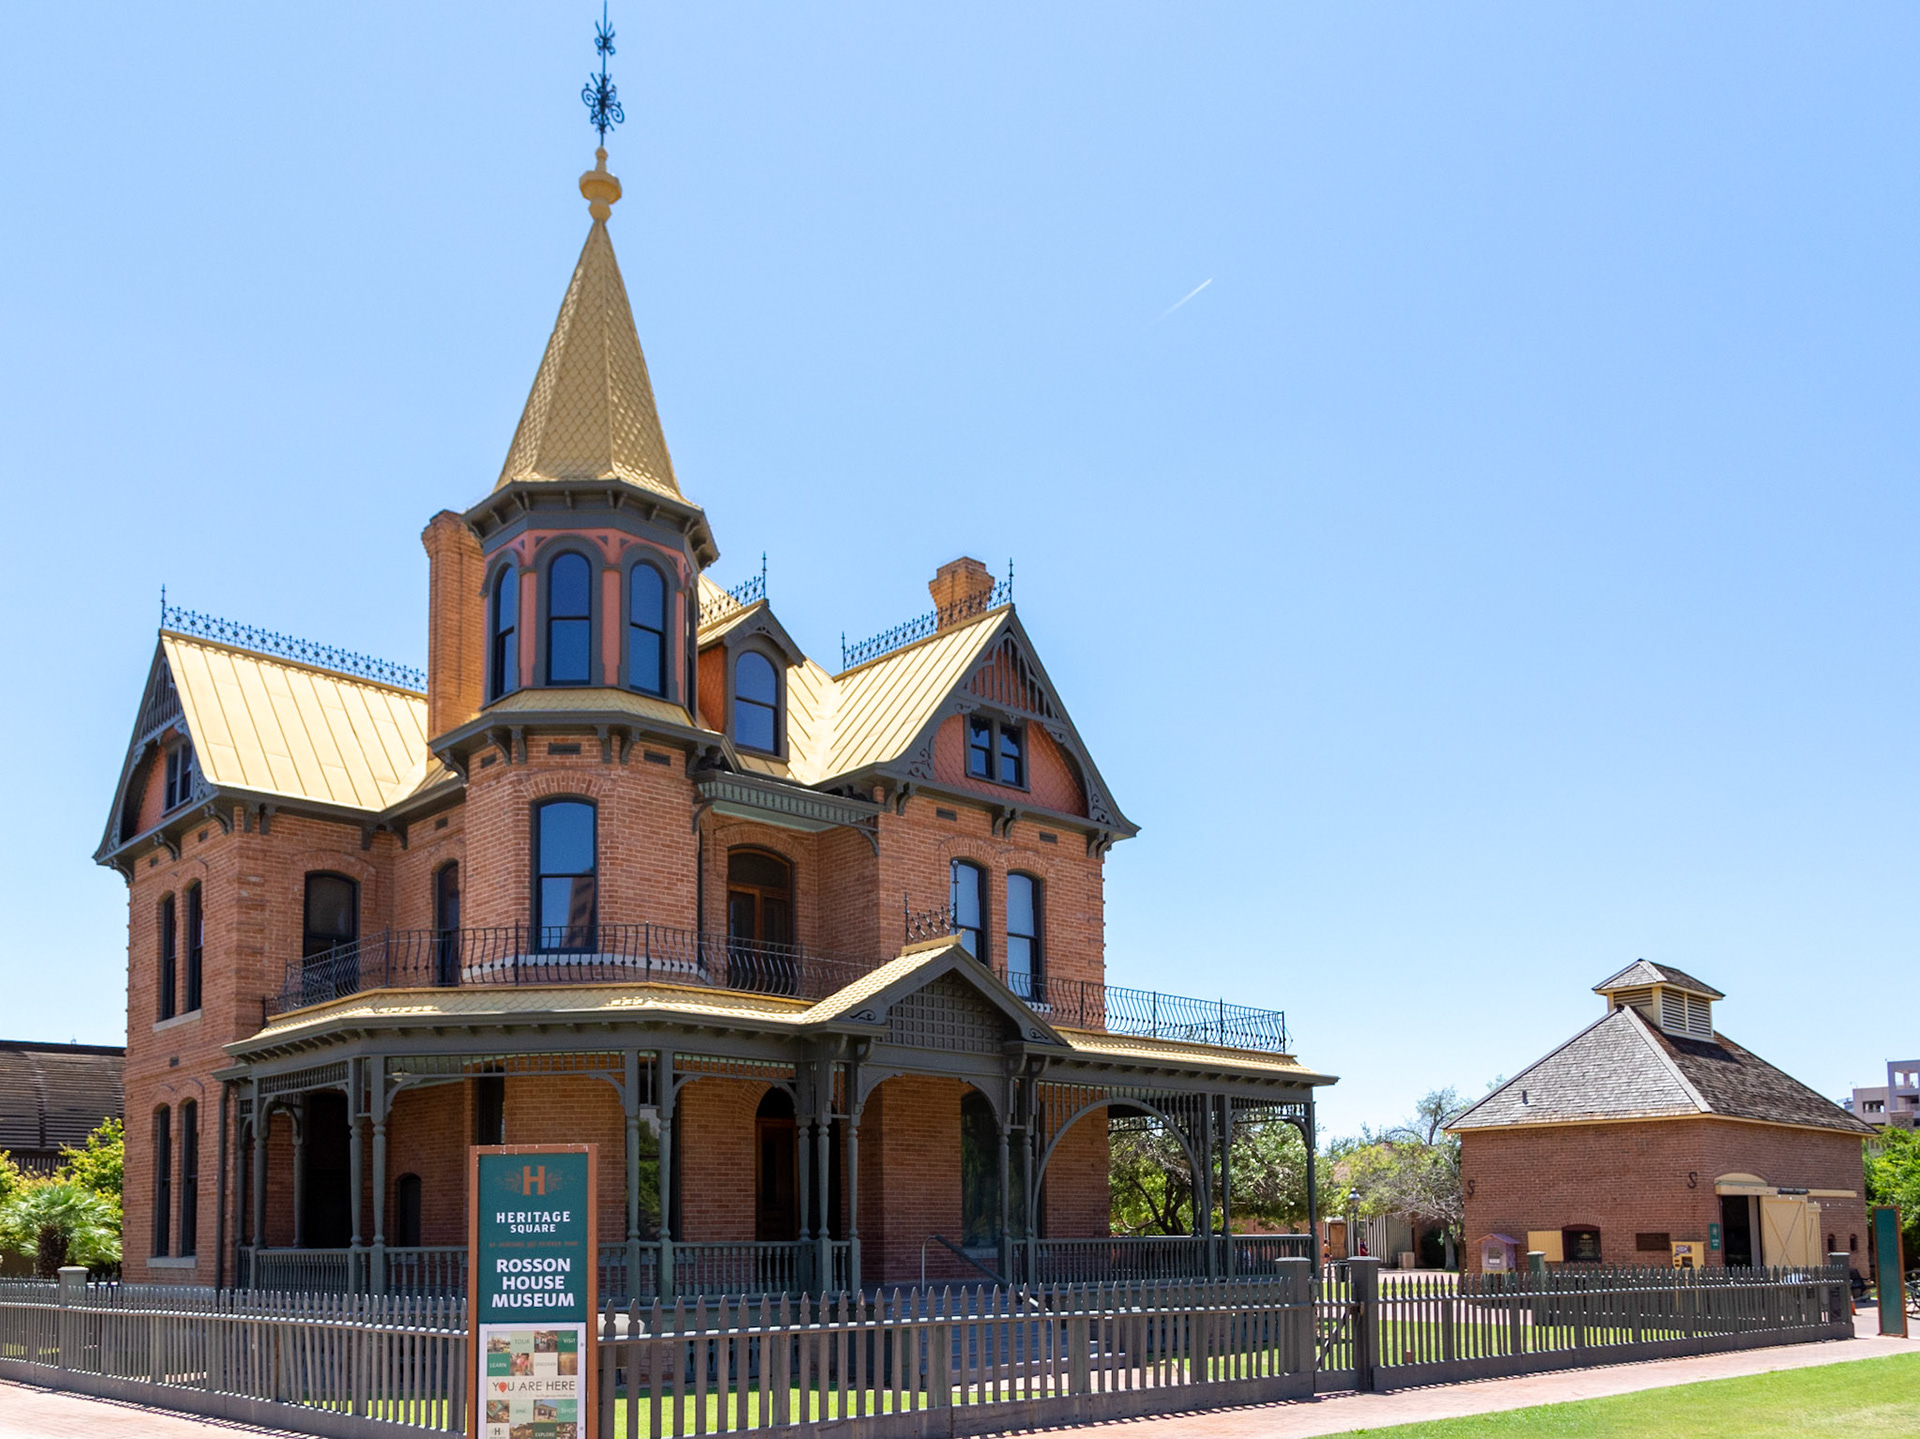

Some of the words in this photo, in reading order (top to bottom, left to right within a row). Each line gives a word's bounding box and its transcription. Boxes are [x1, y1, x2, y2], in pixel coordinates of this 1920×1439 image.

[522, 1165, 546, 1196] H
[496, 1211, 571, 1223] HERITAGE
[510, 1224, 556, 1234] SQUARE
[496, 1258, 571, 1273] ROSSON
[502, 1275, 565, 1290] HOUSE
[491, 1292, 575, 1308] MUSEUM
[519, 1381, 542, 1391] ARE
[546, 1380, 575, 1391] HERE
